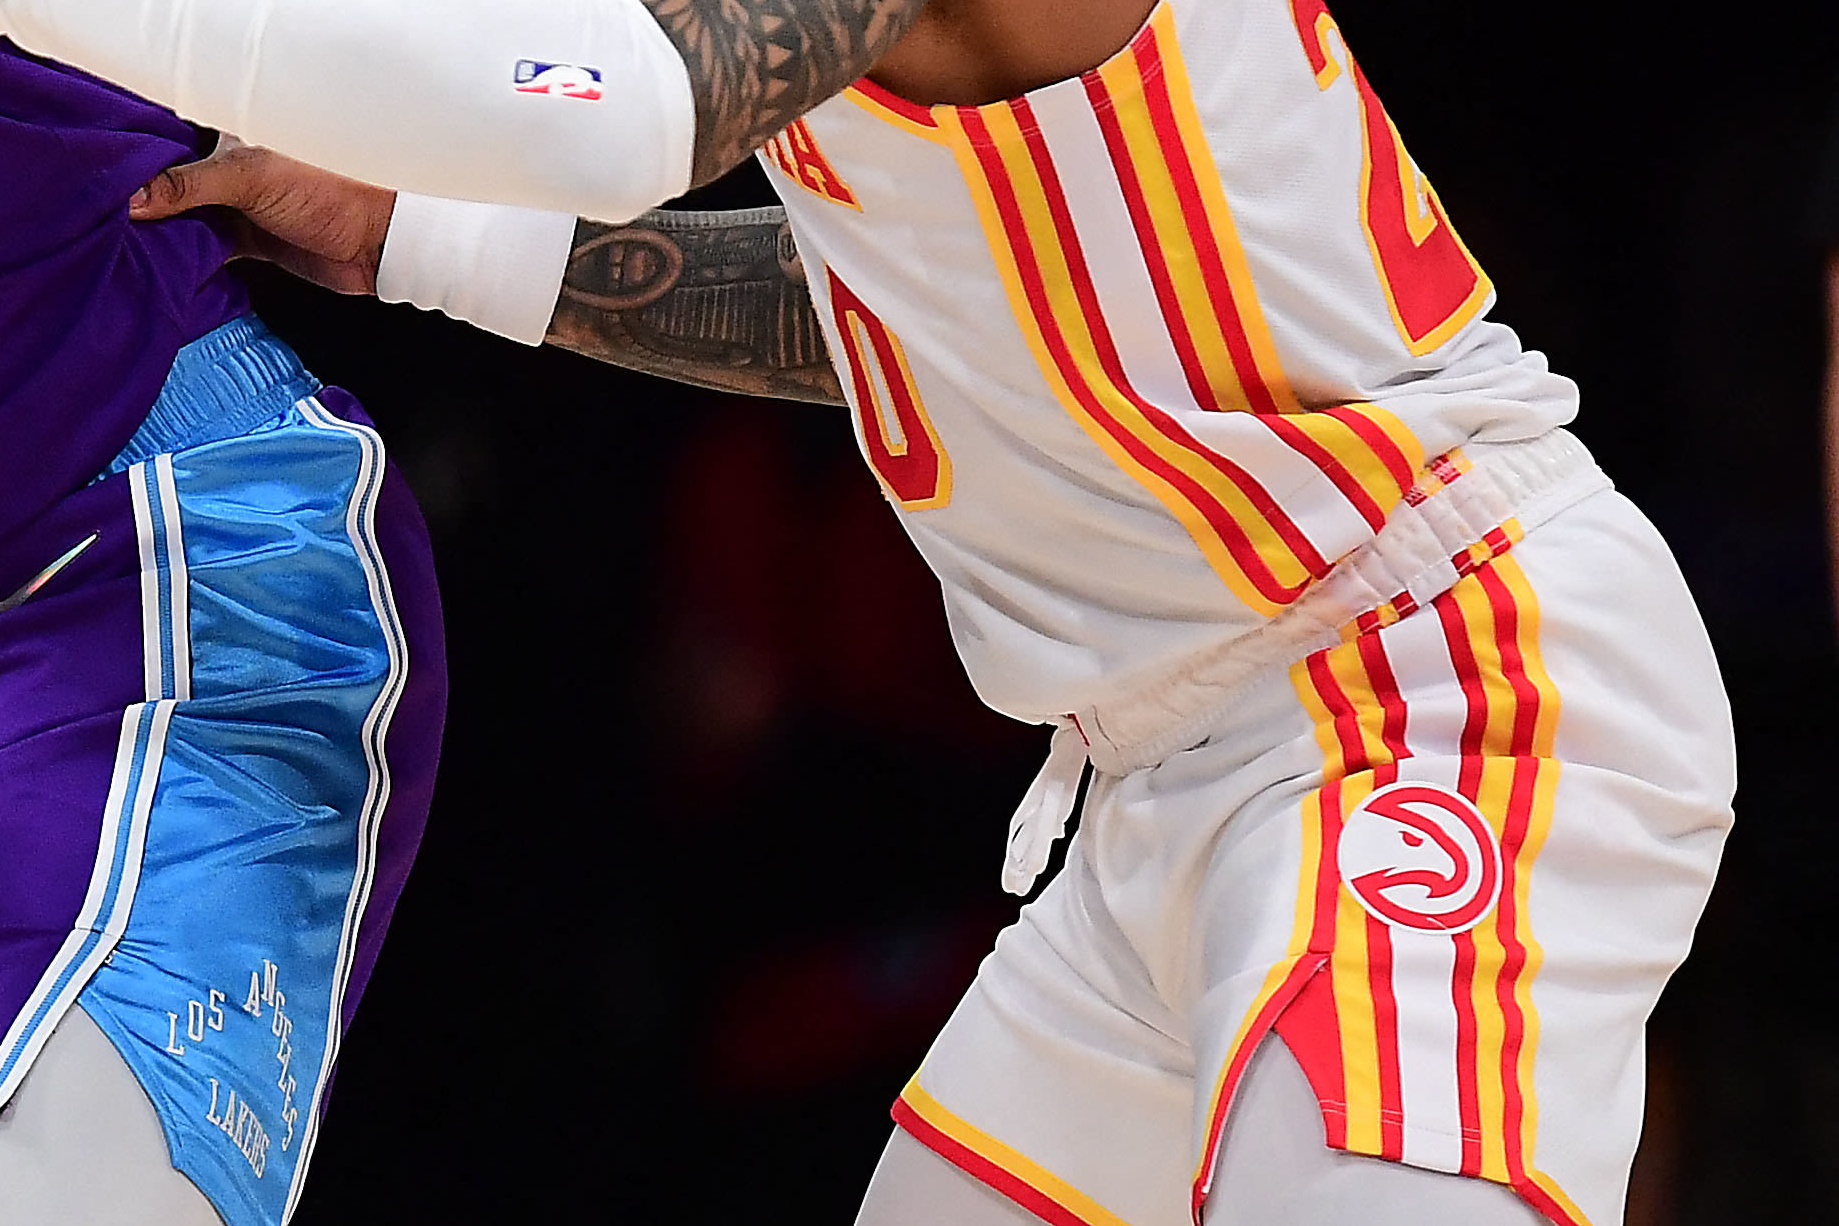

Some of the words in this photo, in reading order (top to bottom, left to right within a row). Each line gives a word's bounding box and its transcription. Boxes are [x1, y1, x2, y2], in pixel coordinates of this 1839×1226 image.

[816, 261, 953, 512] 0
[166, 988, 226, 1056] LOS
[243, 959, 298, 1152] ANGELES
[206, 1077, 271, 1179] LAKERS
